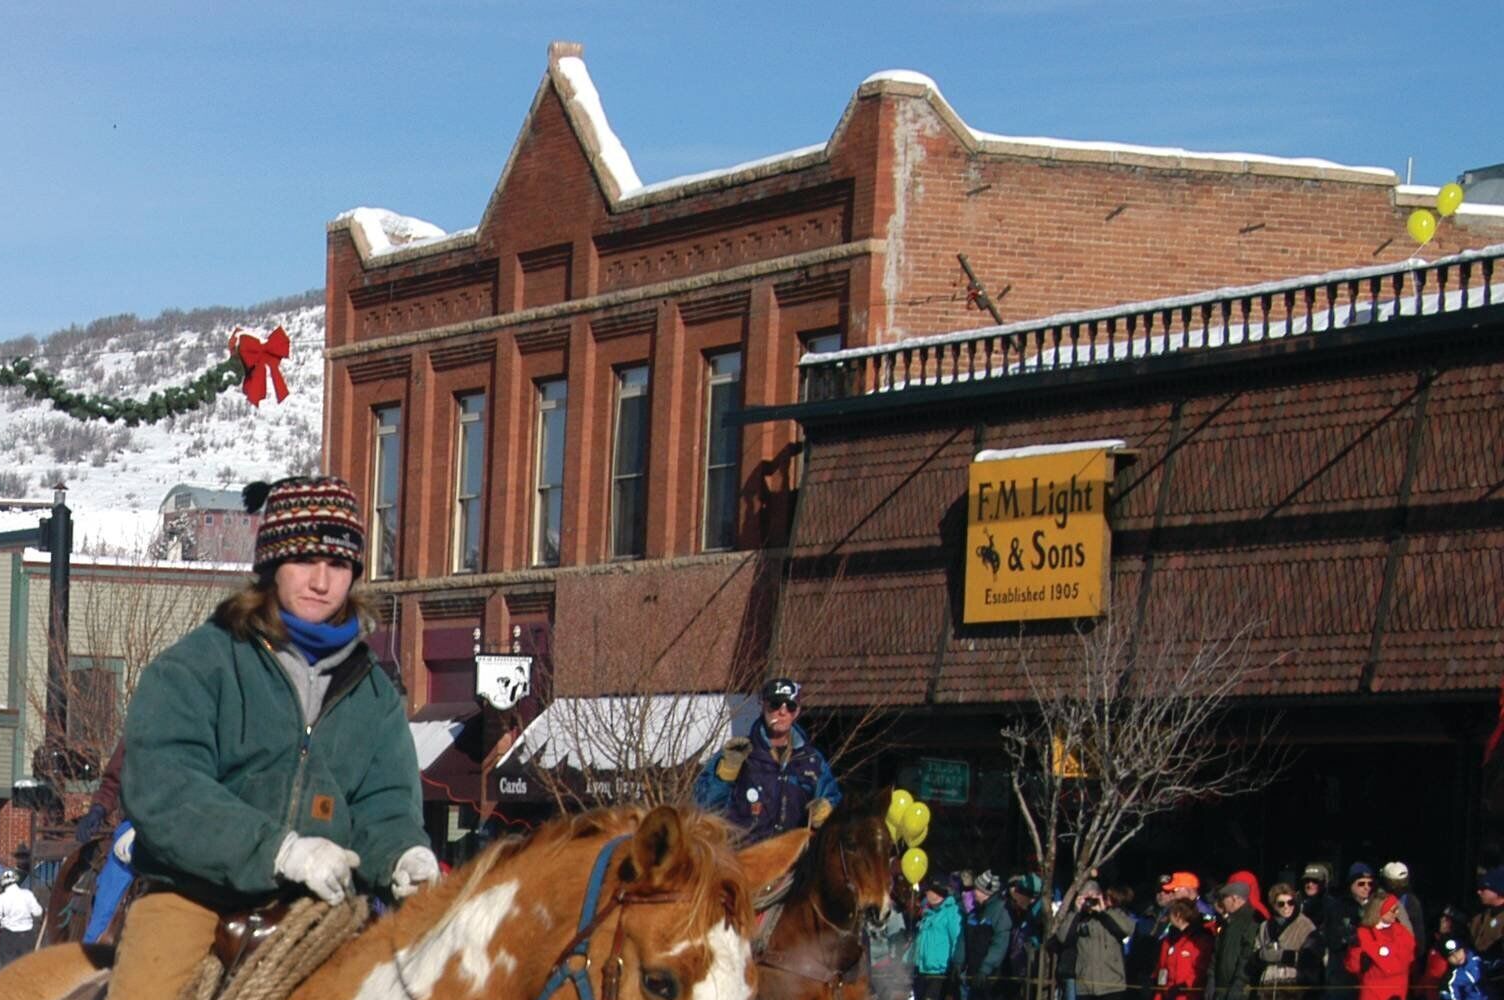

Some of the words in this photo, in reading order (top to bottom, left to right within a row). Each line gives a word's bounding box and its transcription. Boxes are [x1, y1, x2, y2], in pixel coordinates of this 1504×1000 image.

[977, 479, 1025, 521] F.M.
[1031, 474, 1093, 529] Light
[1007, 537, 1025, 571] &
[1031, 530, 1086, 571] Sons
[984, 585, 1046, 606] Established
[1050, 582, 1080, 601] 1905
[499, 777, 527, 794] Cards
